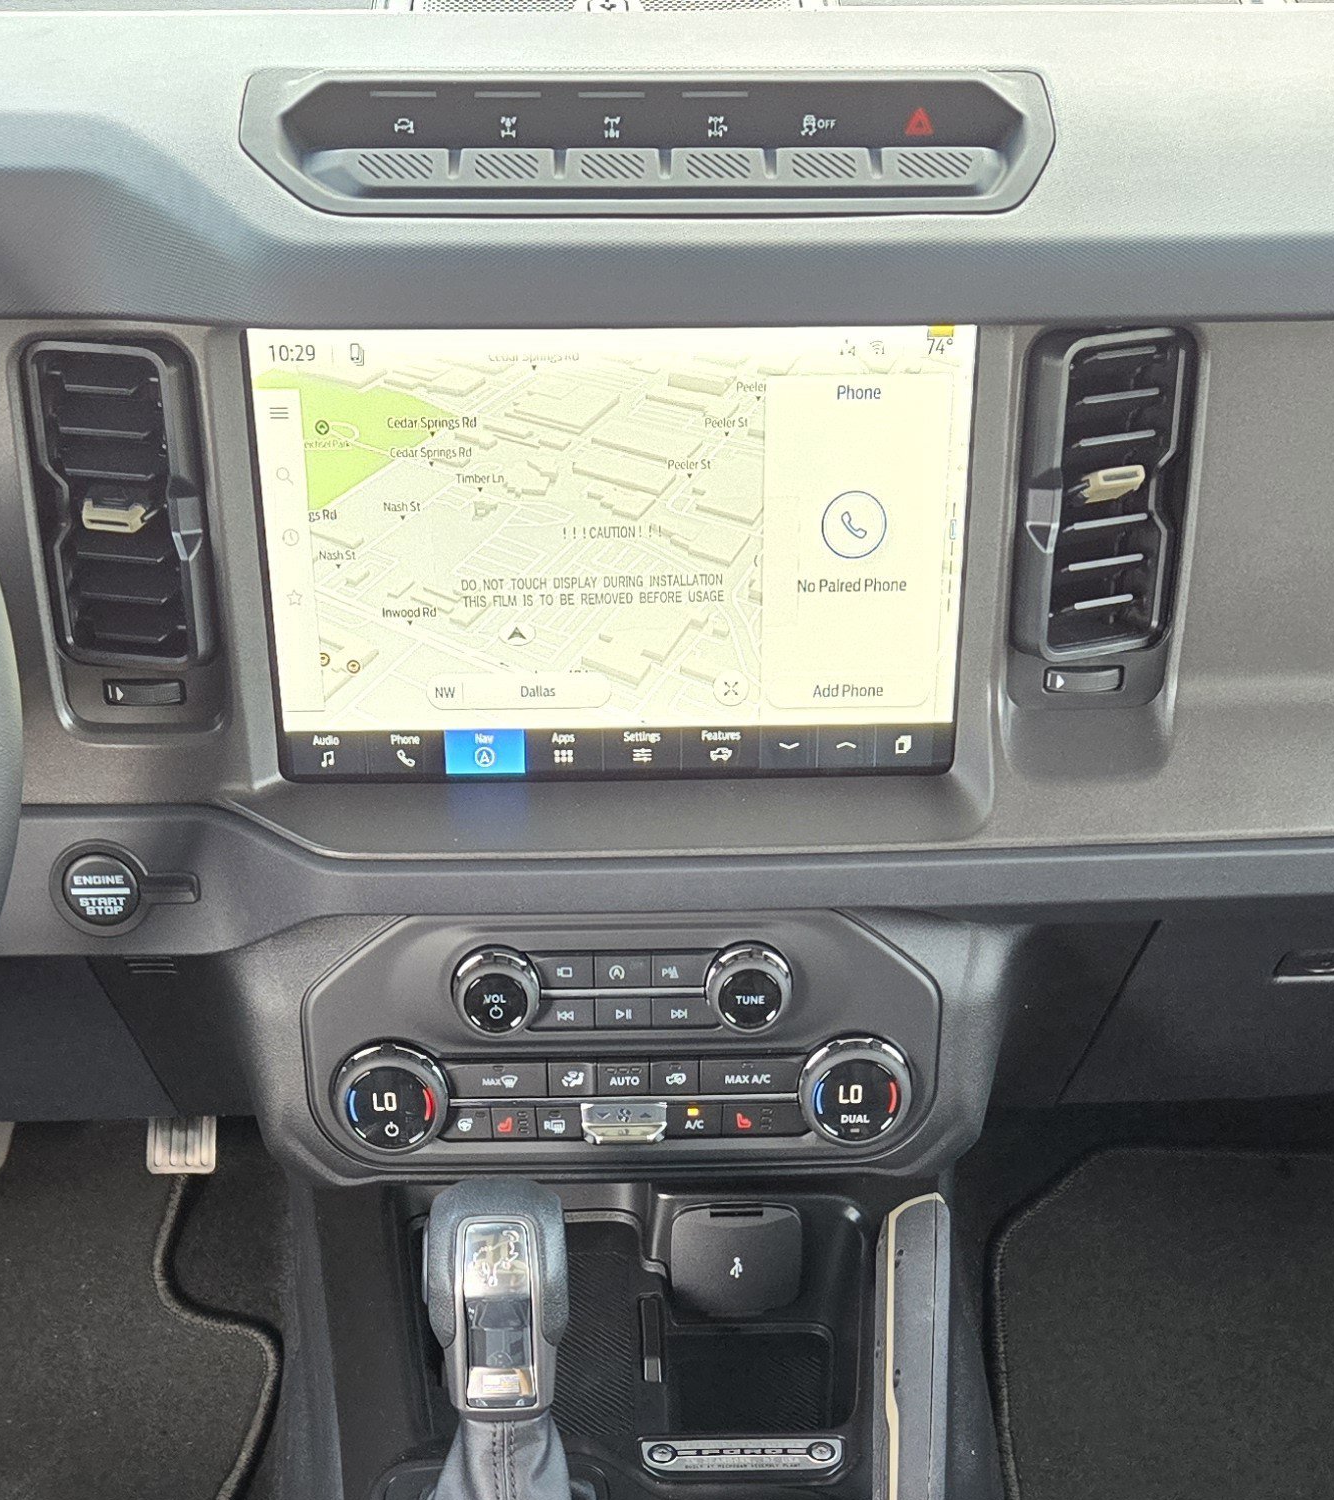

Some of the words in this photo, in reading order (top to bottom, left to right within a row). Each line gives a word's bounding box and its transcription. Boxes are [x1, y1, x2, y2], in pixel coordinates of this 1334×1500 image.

[817, 119, 837, 129] OFF
[269, 345, 316, 362] 10:29
[837, 385, 881, 400] Phone
[387, 417, 417, 429] Cedar
[421, 417, 459, 430] Springs
[462, 416, 477, 429] Rd
[704, 418, 734, 429] Peeler
[737, 417, 748, 428] St
[390, 447, 417, 458] Cedar
[421, 447, 457, 460] Springs
[460, 446, 472, 457] Rd
[668, 460, 697, 471] Peeler
[700, 459, 711, 470] St
[456, 474, 489, 485] Timber
[492, 474, 504, 484] Ln
[383, 502, 406, 512] Nash
[409, 502, 421, 512] St
[322, 510, 337, 521] Rd
[319, 550, 341, 560] Nash
[343, 550, 356, 560] St
[461, 580, 478, 591] DO
[483, 578, 504, 591] NOT
[511, 578, 547, 590] TOUCH
[554, 576, 597, 589] DISPLAY
[603, 575, 643, 588] DURING
[649, 574, 723, 587] INSTALLATION
[798, 579, 817, 593] No
[821, 578, 862, 593] Paired
[865, 578, 907, 592] Phone
[463, 595, 487, 608] THIS
[493, 595, 517, 607] FILM
[523, 595, 534, 607] IS
[540, 594, 554, 606] TO
[561, 594, 575, 606] BE
[581, 592, 633, 605] REMOVED
[639, 592, 682, 604] BEFORE
[688, 590, 725, 603] USAGE
[382, 607, 420, 619] Inwood
[423, 606, 437, 618] Rd
[435, 686, 456, 699] NW
[521, 685, 556, 698] Dallas
[813, 684, 839, 698] Add
[843, 684, 884, 698] Phone
[313, 734, 340, 747] Audio
[391, 734, 420, 746] Phone
[475, 732, 494, 745] Nav
[552, 732, 575, 745] Apps
[623, 730, 661, 745] Settings
[701, 730, 741, 742] Features
[73, 875, 125, 886] ENGINE
[79, 897, 126, 907] START
[86, 906, 124, 916] STOP
[483, 994, 507, 1005] VOL
[735, 994, 766, 1005] TUNE
[482, 1076, 501, 1087] MAX
[609, 1075, 641, 1087] AUTO
[725, 1074, 750, 1085] MAX
[751, 1073, 771, 1085] A/C
[685, 1118, 705, 1130] A/C
[841, 1114, 870, 1124] DUAL
